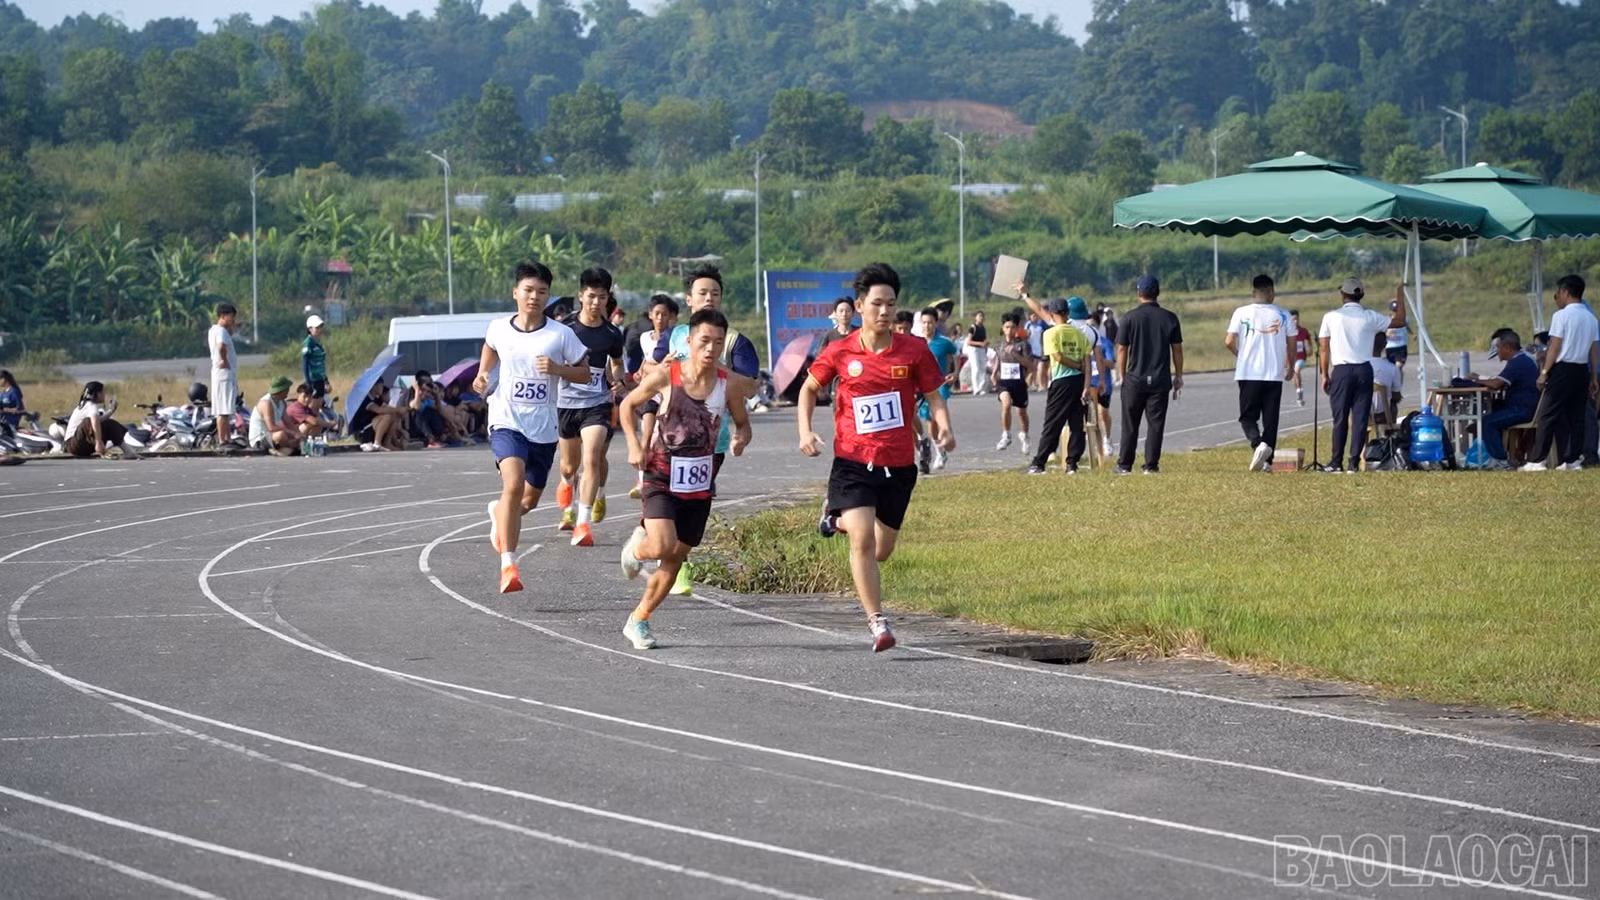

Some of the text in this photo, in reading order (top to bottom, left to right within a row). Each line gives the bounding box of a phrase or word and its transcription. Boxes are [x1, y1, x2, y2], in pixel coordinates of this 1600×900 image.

[513, 381, 547, 400] 258
[860, 400, 898, 424] 211
[676, 464, 709, 486] 188
